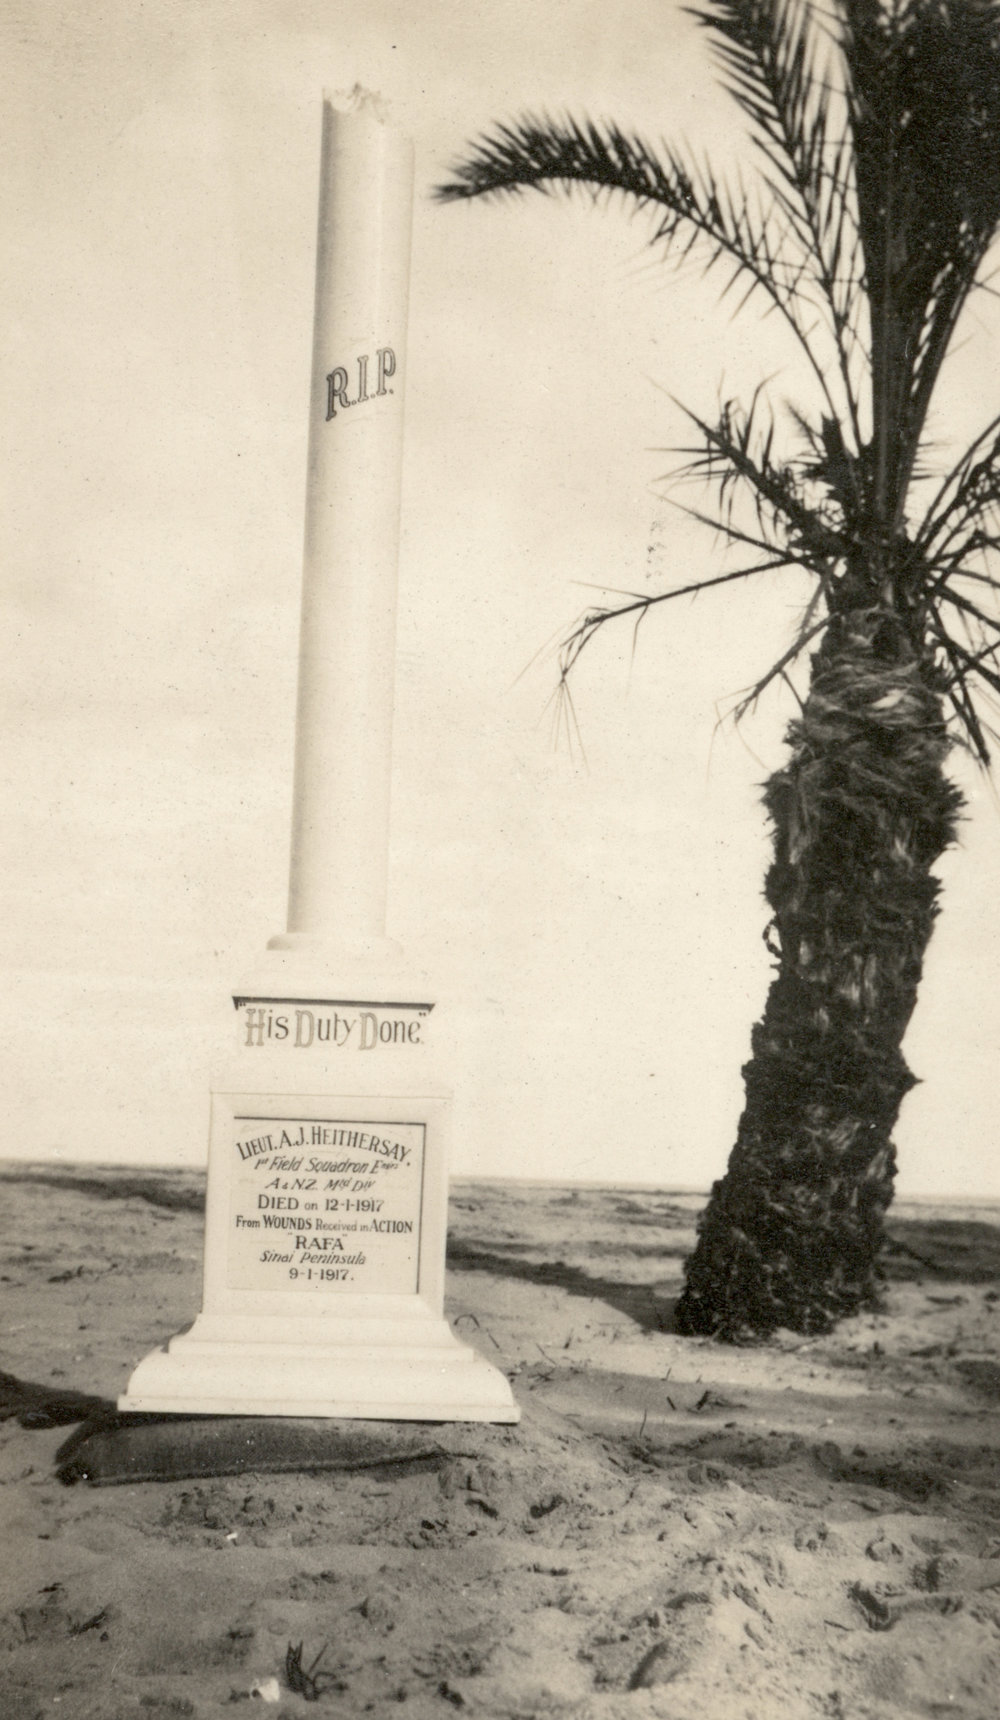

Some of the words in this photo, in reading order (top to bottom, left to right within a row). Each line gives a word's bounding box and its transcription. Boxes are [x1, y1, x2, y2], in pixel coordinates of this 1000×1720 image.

[325, 347, 396, 421] R.I.P.
[294, 1010, 356, 1048] Duty
[236, 1135, 278, 1160] LIEUT.
[269, 1156, 304, 1172] Field
[305, 1157, 369, 1174] Squadron
[257, 1194, 300, 1210] DIED
[325, 1198, 385, 1213] 12-1-1917
[235, 1215, 261, 1229] From
[262, 1215, 313, 1231] WOUNDS
[315, 1218, 357, 1232] Received
[360, 1224, 369, 1232] in
[370, 1218, 413, 1234] ACTION
[260, 1250, 296, 1264] Sinai
[300, 1251, 367, 1266] Peninsula
